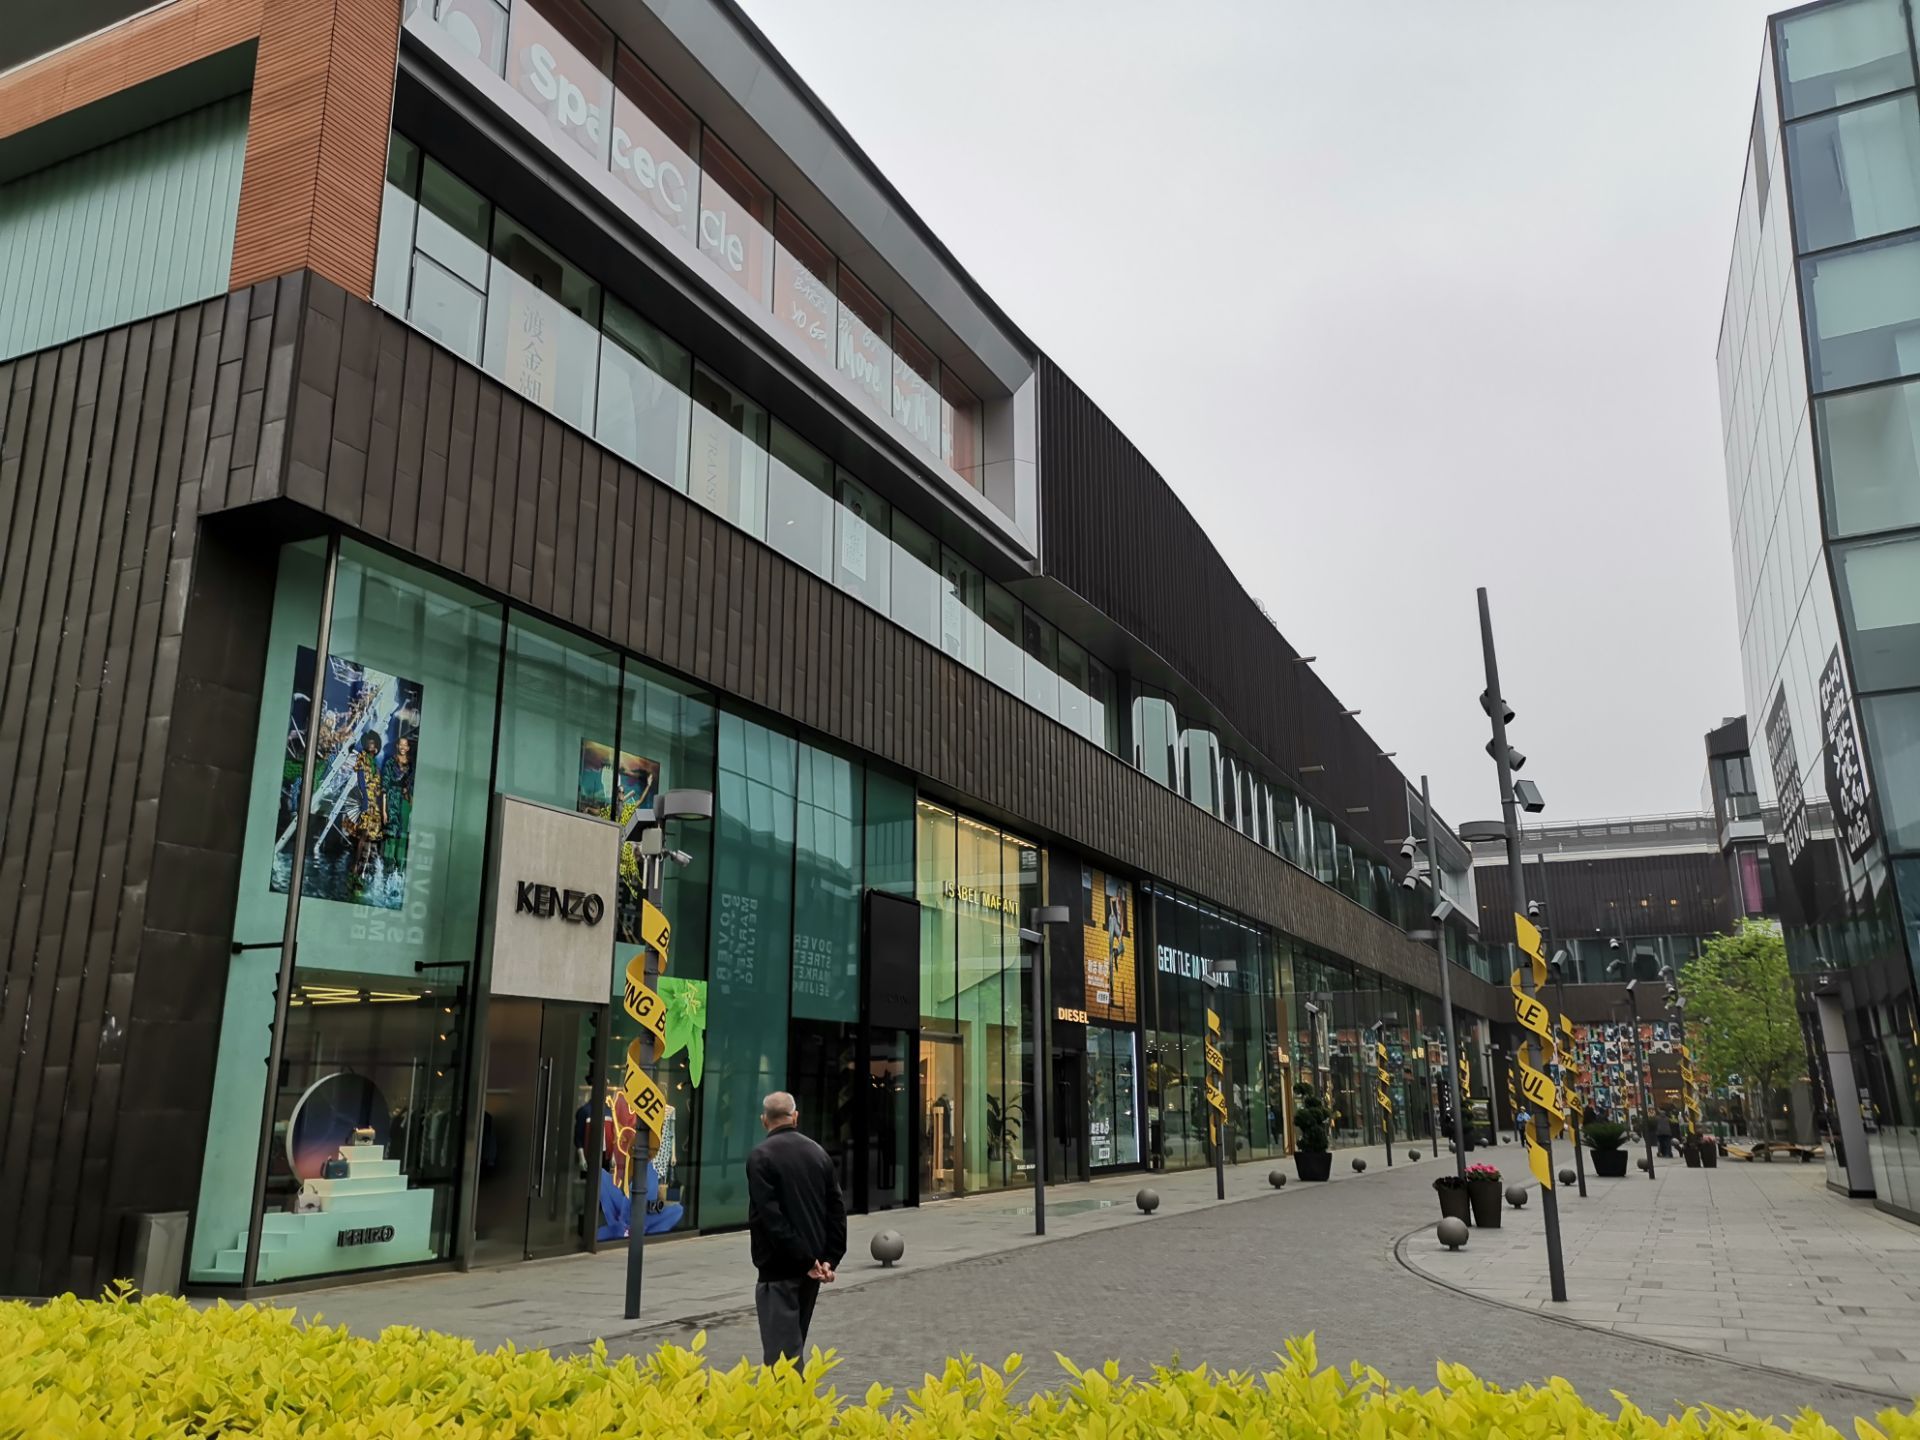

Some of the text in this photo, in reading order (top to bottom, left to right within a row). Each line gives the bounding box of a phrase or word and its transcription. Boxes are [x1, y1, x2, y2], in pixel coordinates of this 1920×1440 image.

[530, 43, 743, 271] SpaceCcle
[515, 880, 604, 927] KENZO
[1058, 1007, 1090, 1024] DIESEL
